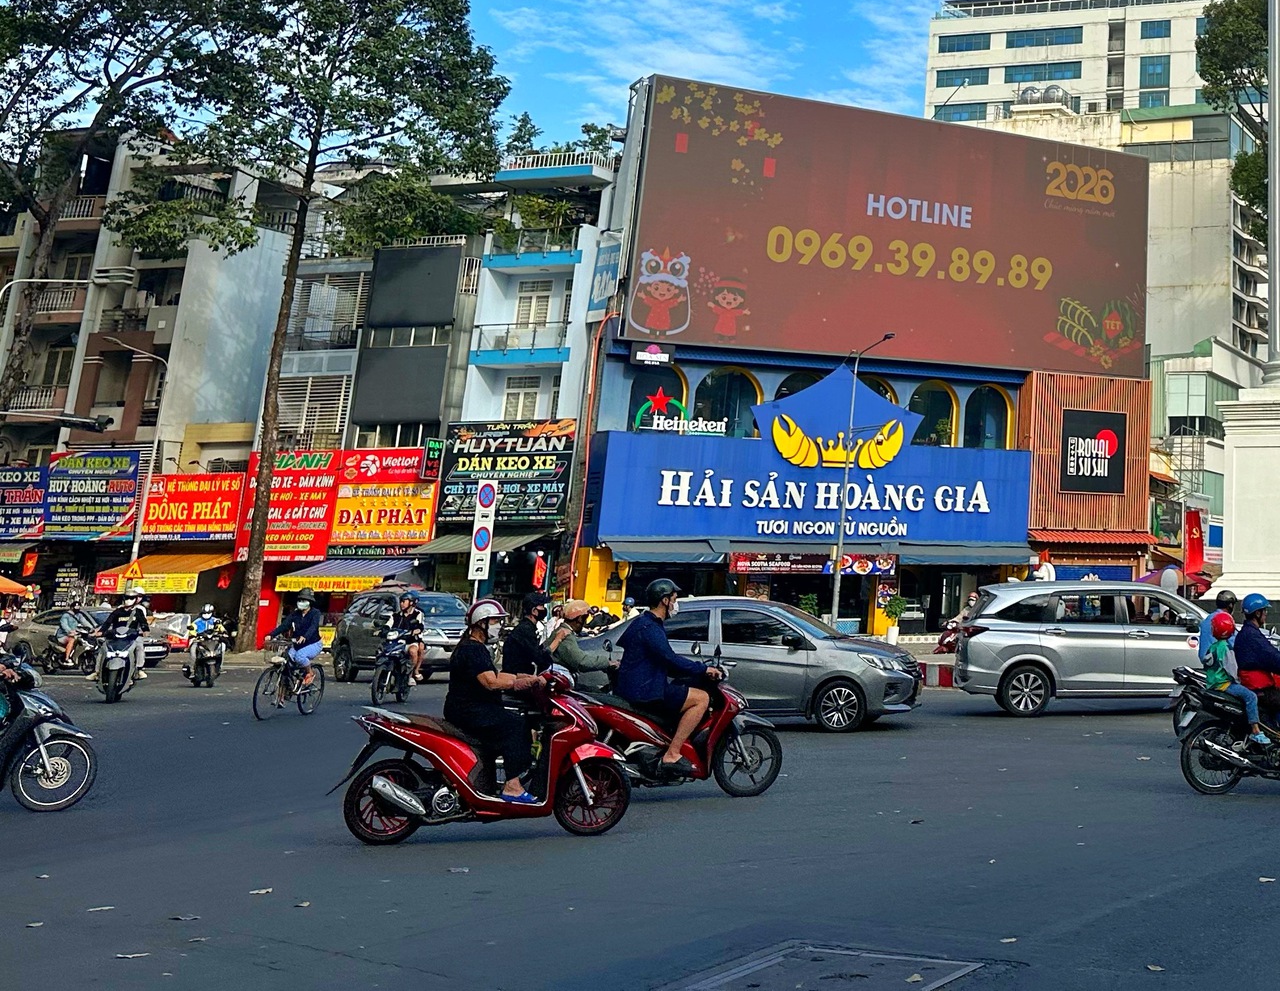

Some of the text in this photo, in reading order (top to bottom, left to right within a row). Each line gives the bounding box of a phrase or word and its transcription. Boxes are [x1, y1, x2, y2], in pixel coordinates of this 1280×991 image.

[1045, 161, 1115, 205] 2026
[866, 192, 973, 229] HOTLINE
[765, 224, 1053, 291] 0969.39.89.89
[652, 414, 728, 433] Heineken
[1078, 437, 1111, 459] ROYAL
[382, 456, 419, 468] Vietlott
[456, 454, 557, 472] DÁN KEO XE
[1078, 457, 1109, 477] SUSHI
[23, 472, 40, 483] XE
[49, 477, 136, 494] HUY HOÀNG AUTO
[282, 476, 293, 488] XE
[298, 474, 315, 487] DÁN
[316, 472, 335, 487] KÍNH
[299, 492, 310, 501] XE
[465, 484, 478, 495] TE
[527, 483, 541, 493] XE
[542, 482, 565, 493] MÁY
[658, 468, 991, 514] HẢI SẢN HOÀNG GIA
[148, 493, 231, 521] ĐỒNG PHÁT
[339, 503, 428, 530] ĐẠI PHÁT
[11, 517, 22, 525] XE
[756, 515, 907, 536] TƯƠI NGON TỪ NGUỒN
[295, 532, 314, 541] LOGO
